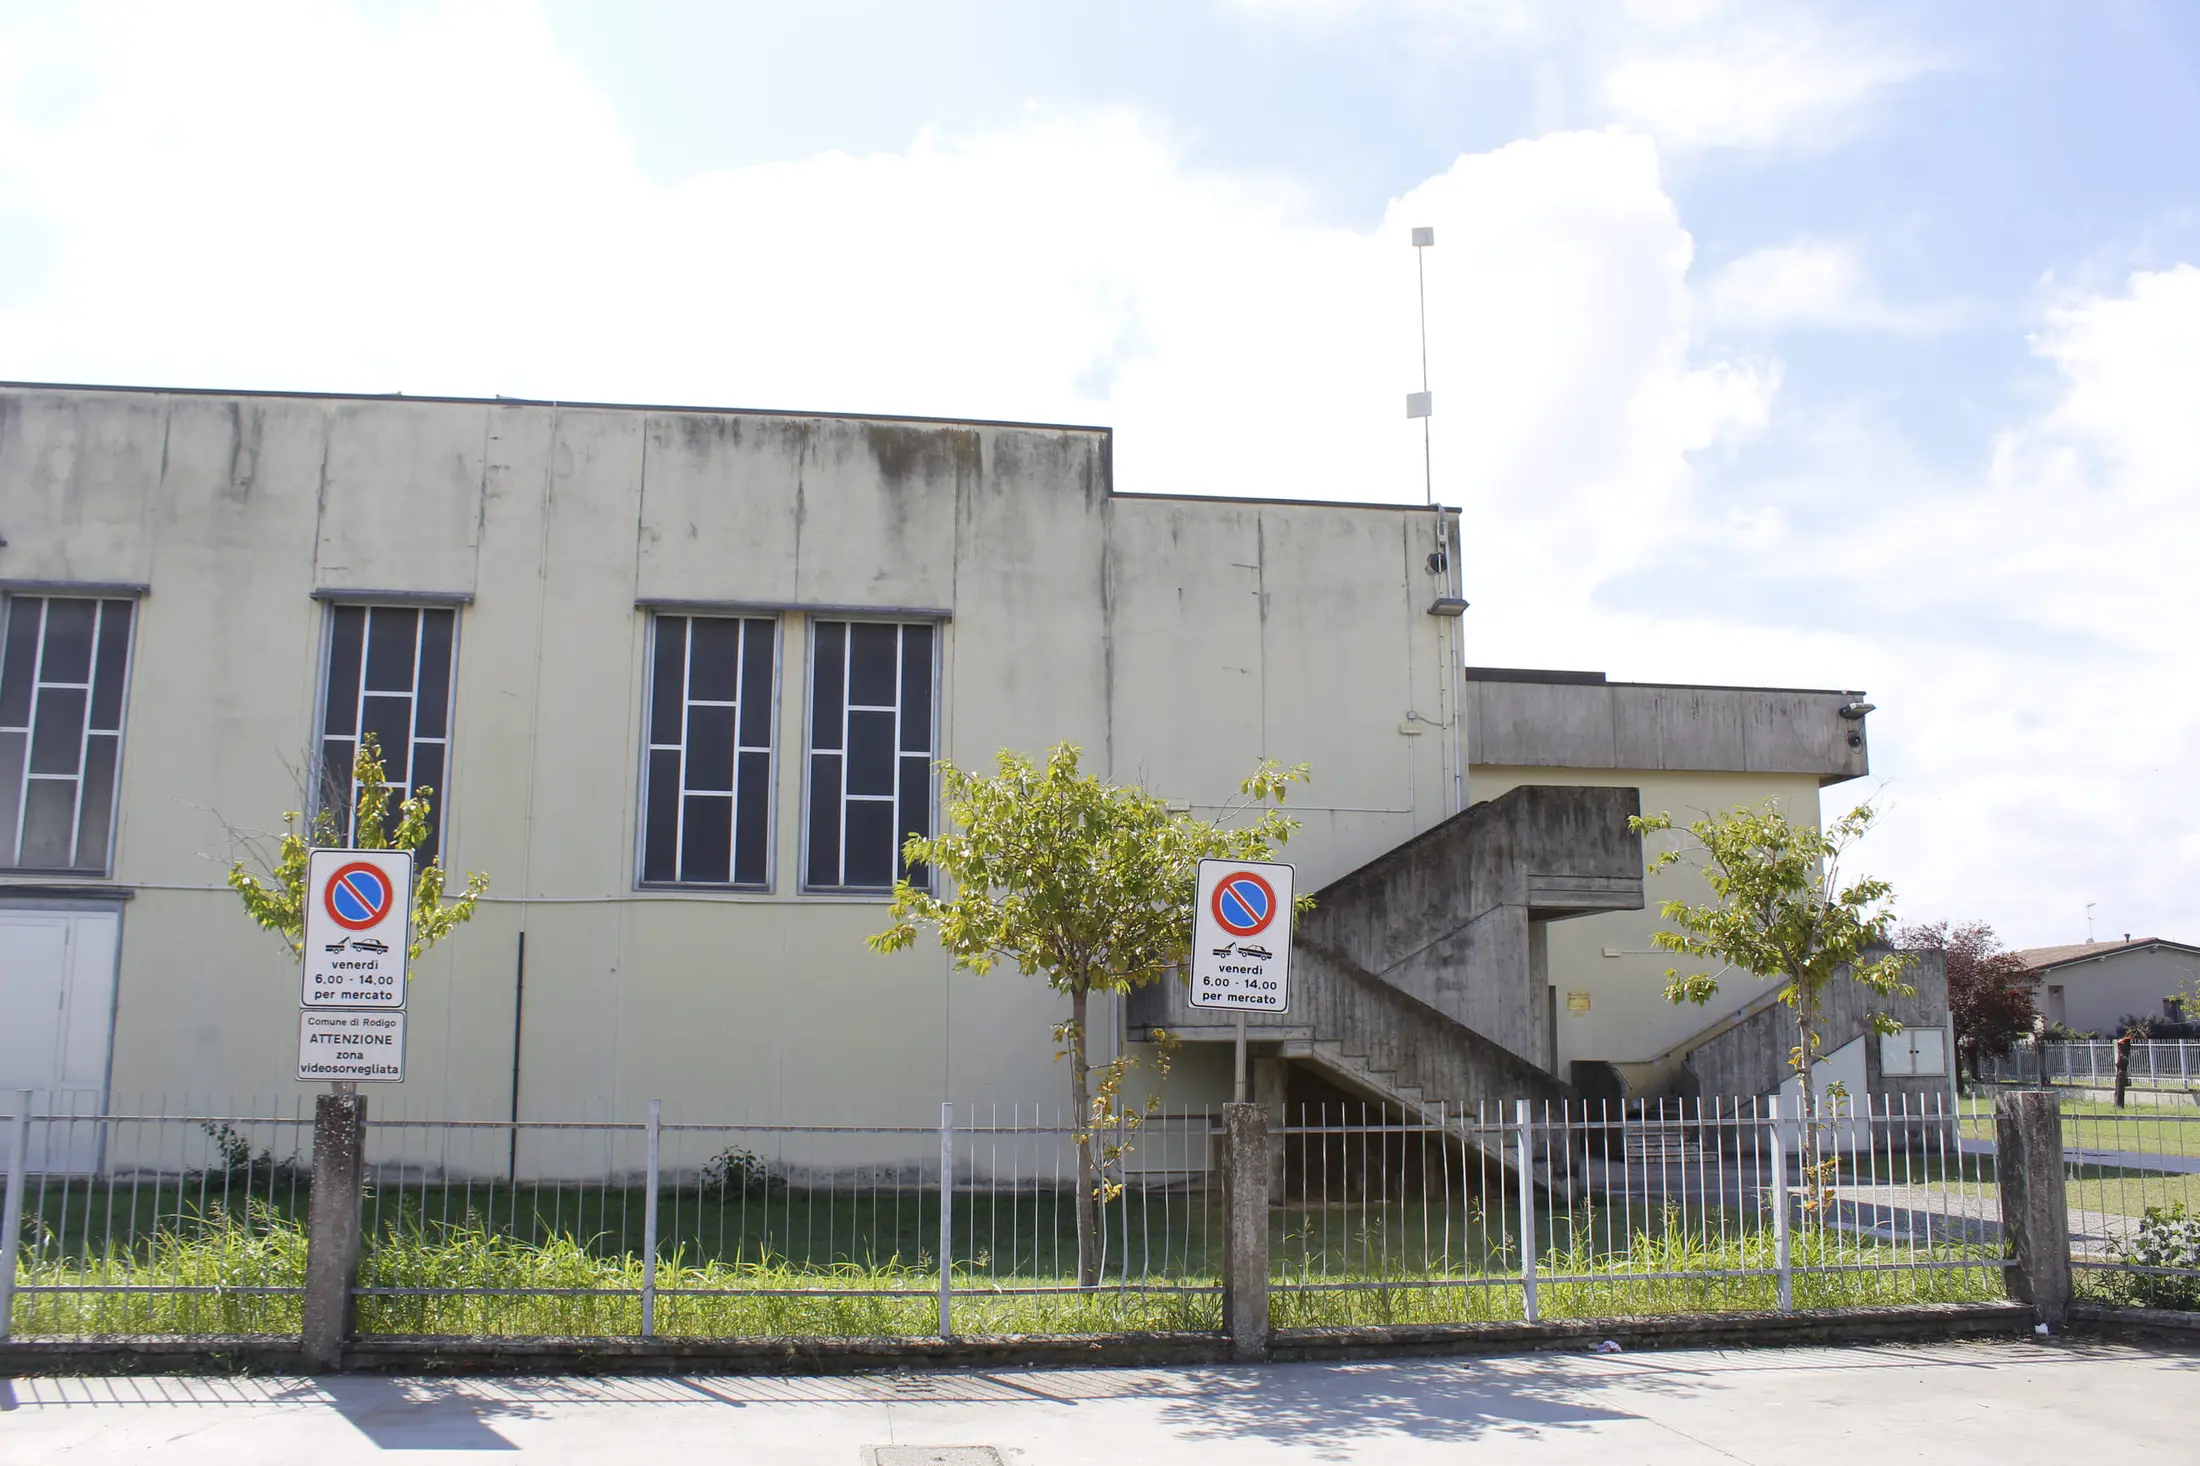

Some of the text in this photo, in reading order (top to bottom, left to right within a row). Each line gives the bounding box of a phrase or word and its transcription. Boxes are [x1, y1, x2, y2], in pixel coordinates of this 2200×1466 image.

[315, 974, 343, 985] 6.00
[359, 975, 394, 986] 14.00
[1203, 976, 1230, 987] 6.00
[1244, 979, 1277, 990] 14.00
[314, 990, 393, 1001] per mercato
[1202, 992, 1276, 1004] per mercato
[307, 1017, 396, 1029] Comune di Rodigo
[310, 1034, 392, 1045] ATTENZIONE
[336, 1051, 364, 1060] zona
[300, 1063, 399, 1076] videosorvegliata
